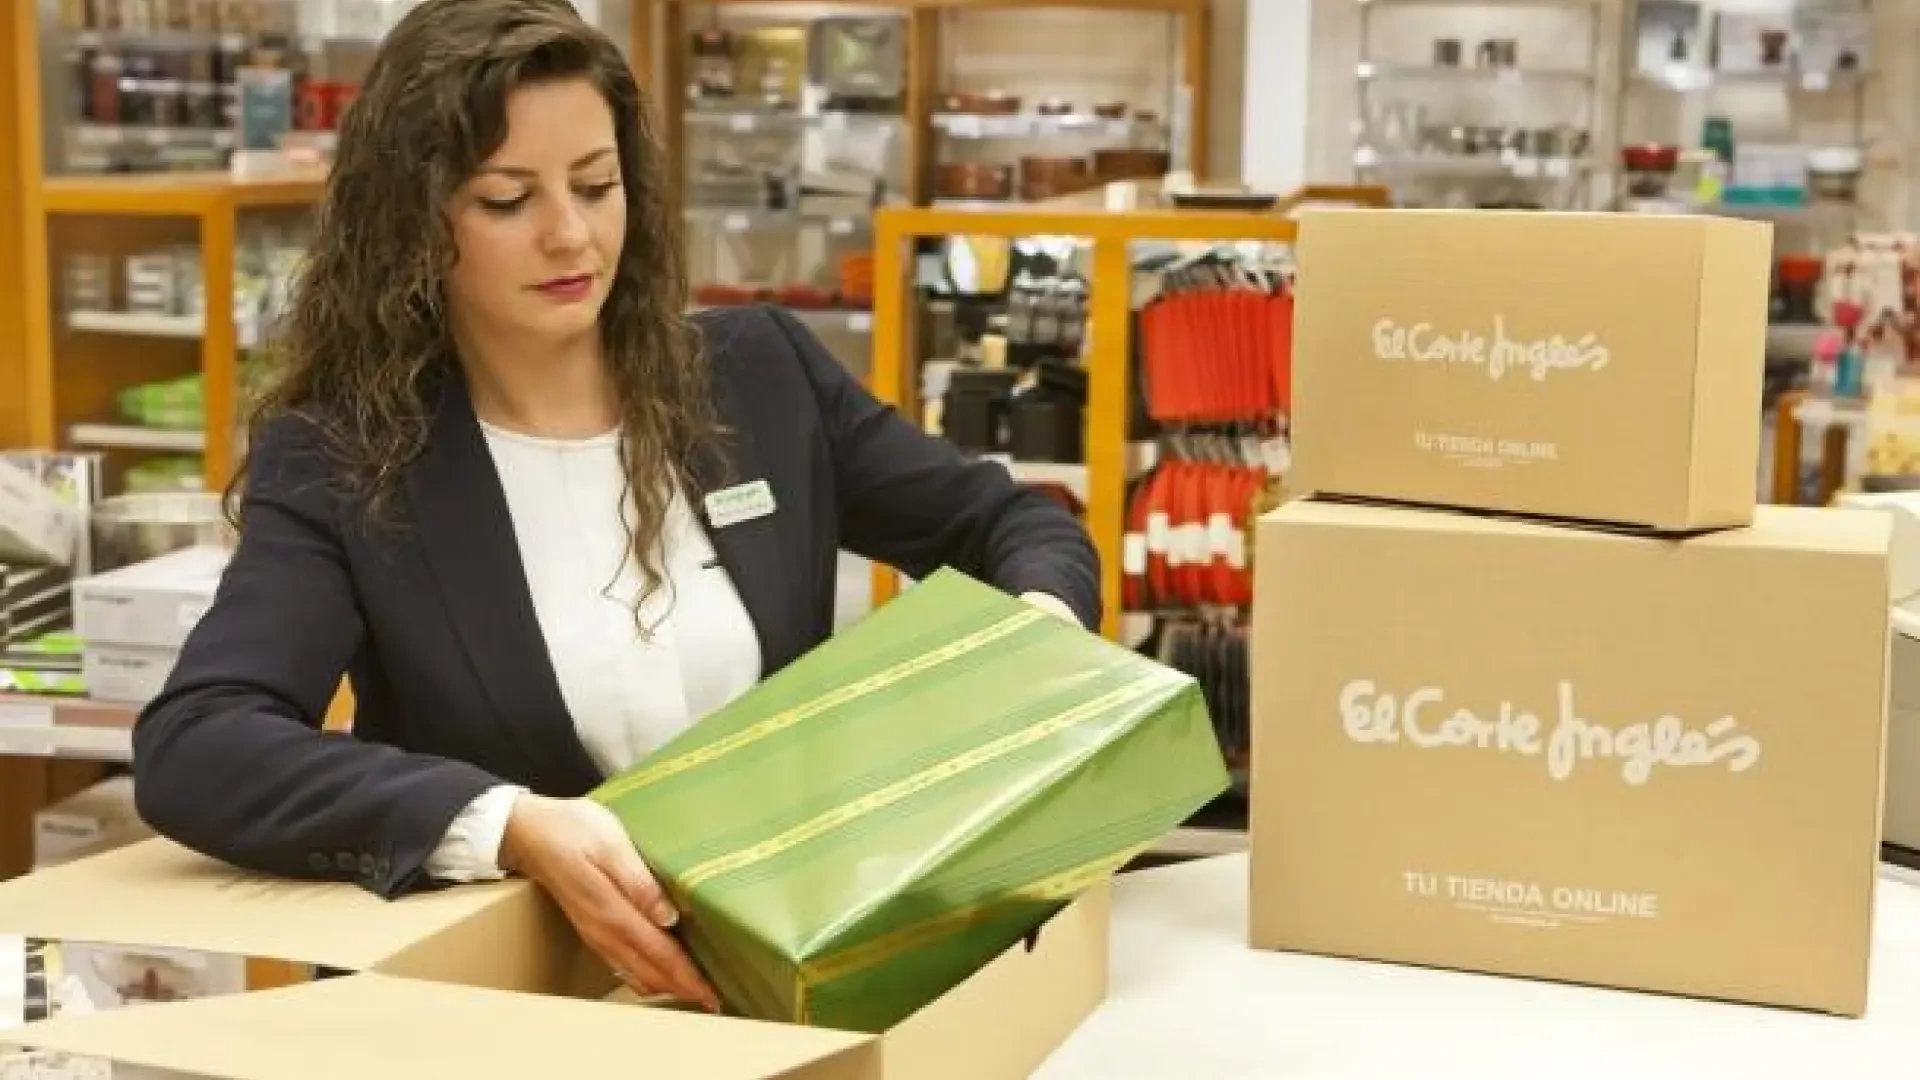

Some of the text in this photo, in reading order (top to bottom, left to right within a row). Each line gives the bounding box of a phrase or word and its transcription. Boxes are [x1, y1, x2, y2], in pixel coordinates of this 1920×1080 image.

[1373, 317, 1405, 359] El
[1408, 321, 1485, 364] Corte
[1340, 679, 1762, 788] El Corte Inglés
[1402, 871, 1660, 919] TU TIENDA ONLINE
